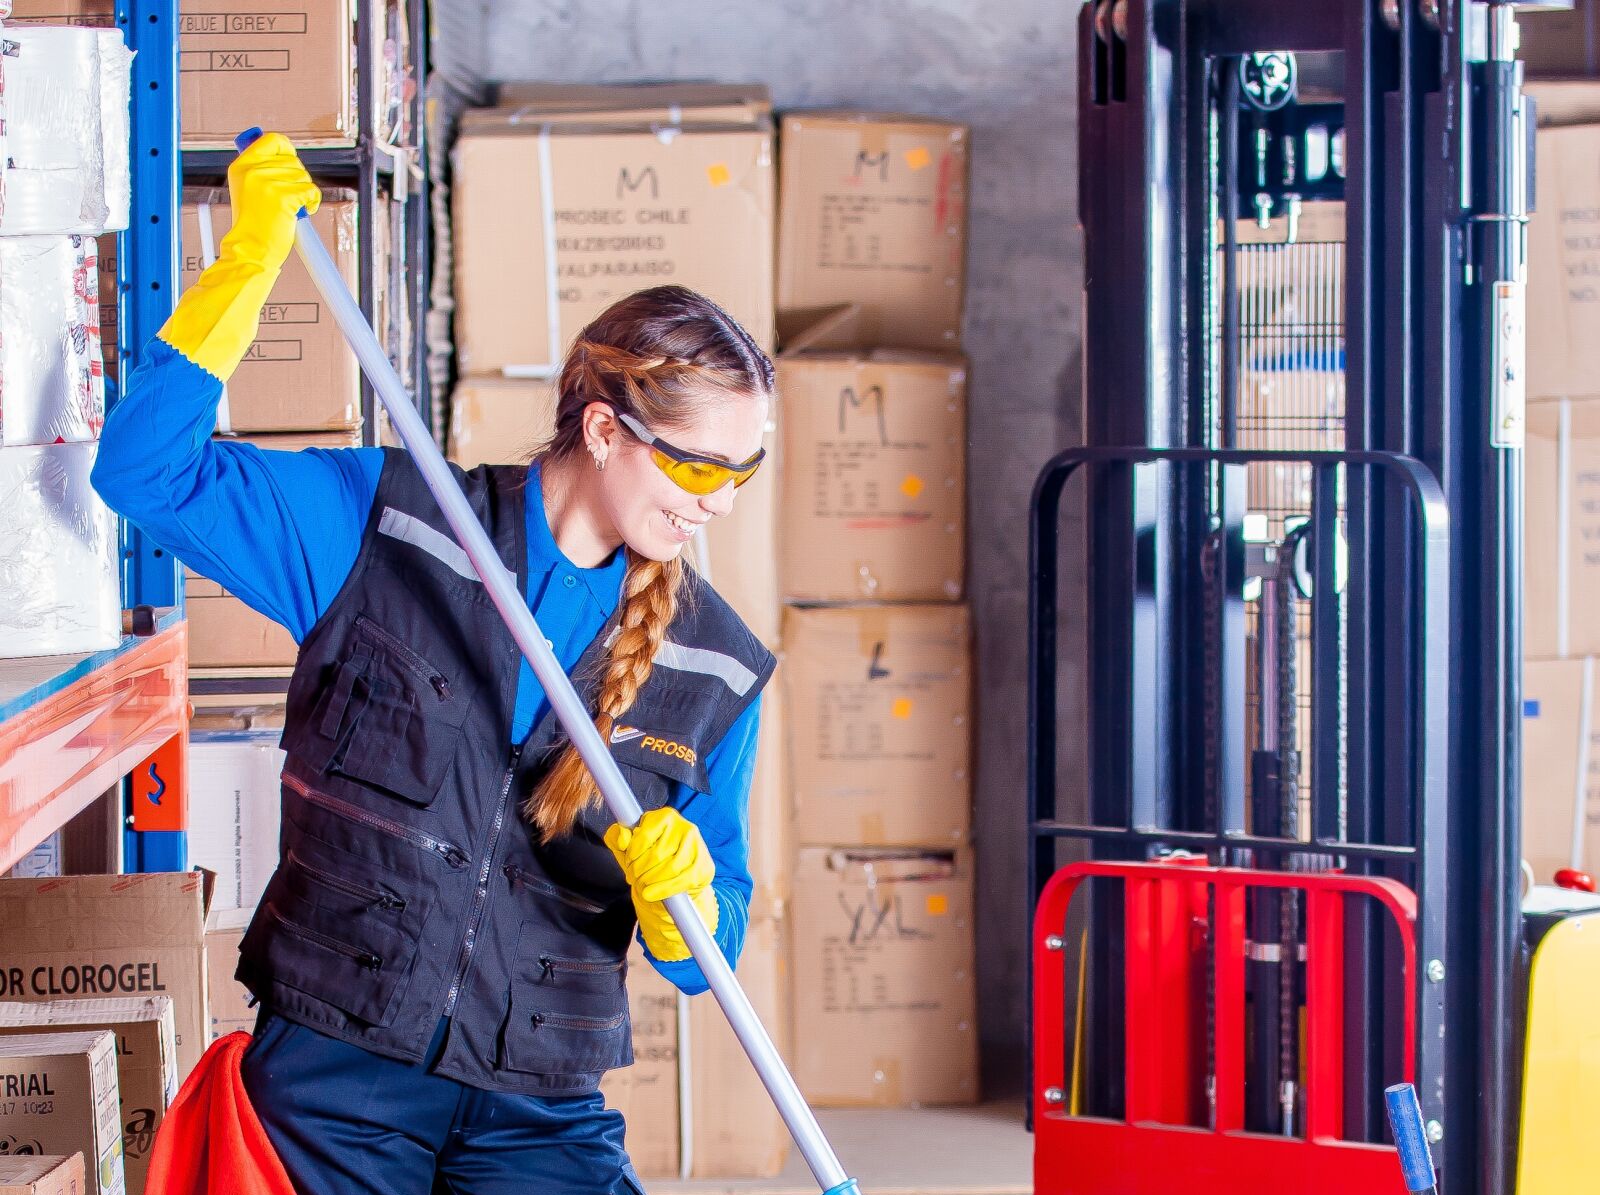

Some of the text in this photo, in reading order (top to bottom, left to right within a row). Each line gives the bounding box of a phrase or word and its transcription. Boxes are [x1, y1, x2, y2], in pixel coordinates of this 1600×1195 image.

[231, 16, 277, 31] GREY
[219, 53, 255, 68] XXL
[616, 165, 658, 199] M
[853, 150, 889, 182] M
[635, 208, 690, 225] CHILE
[839, 385, 889, 447] M
[31, 962, 166, 996] CLOROGEL
